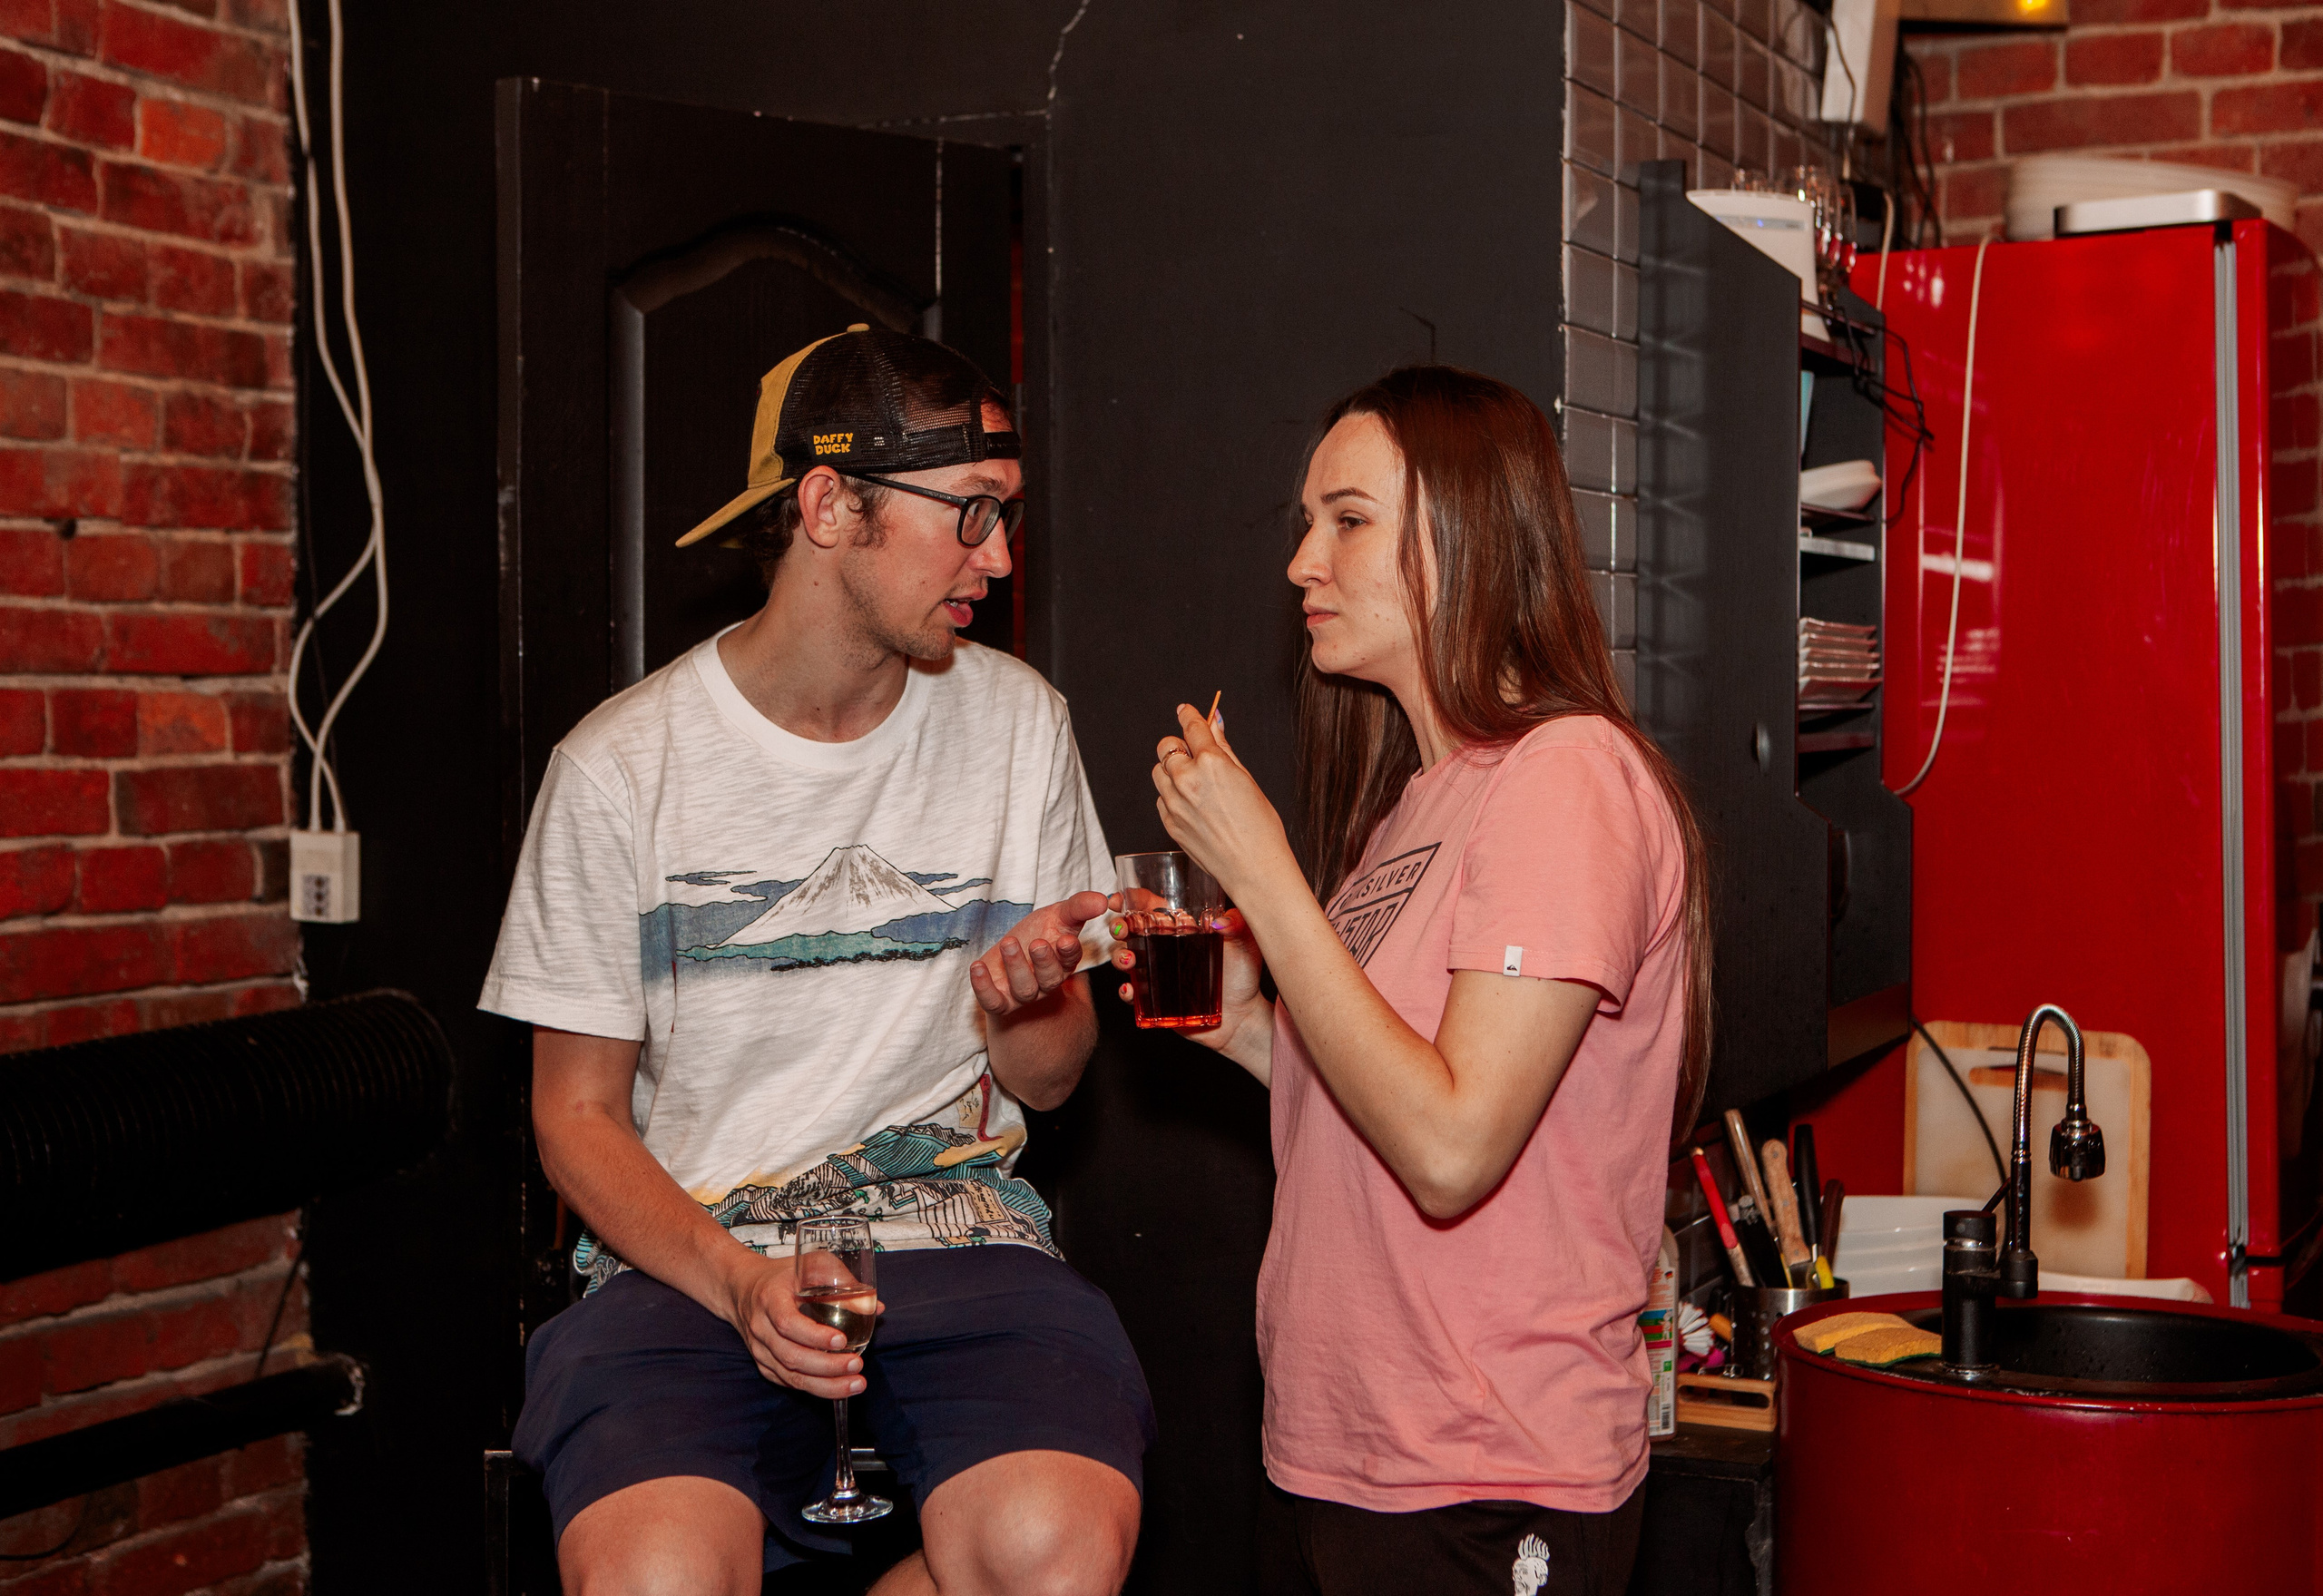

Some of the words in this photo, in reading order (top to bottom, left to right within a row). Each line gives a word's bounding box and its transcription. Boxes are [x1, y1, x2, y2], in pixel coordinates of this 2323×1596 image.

[813, 432, 854, 445] DAFFY
[815, 443, 850, 455] DUCK
[1339, 861, 1422, 910] SILVER
